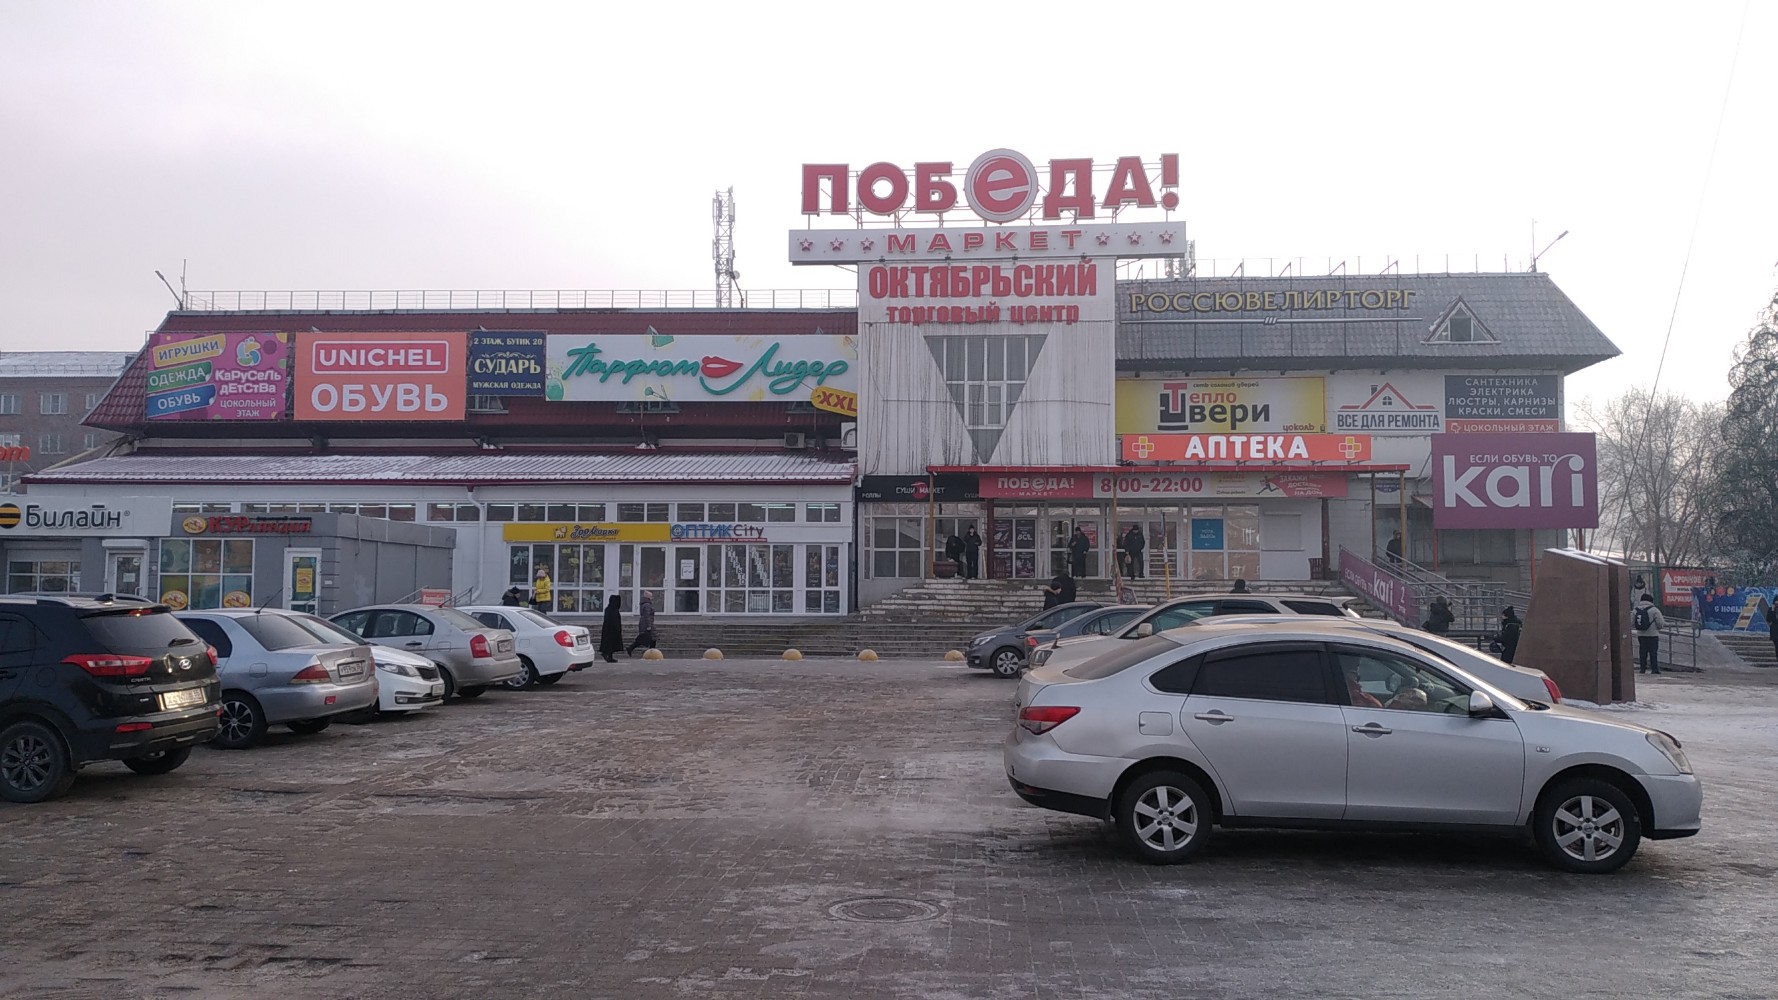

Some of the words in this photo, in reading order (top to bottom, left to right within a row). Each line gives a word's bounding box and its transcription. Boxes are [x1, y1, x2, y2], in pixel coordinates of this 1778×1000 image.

[887, 230, 1083, 252] МАРКЕТ
[869, 258, 1097, 299] ОКТЯБРЬСКИЙ
[1129, 288, 1416, 314] РОССЮВЕЛИРТОРГ
[886, 301, 1000, 326] торговый
[1010, 305, 1080, 326] центр
[159, 341, 219, 360] ИГРУШКИ
[481, 338, 504, 346] ЭТАЖ,
[319, 349, 442, 366] UNICHEL
[474, 358, 541, 376] СУДАРЬ
[149, 368, 206, 387] ОДЕЖДА
[700, 342, 849, 395] Лидер
[1465, 378, 1538, 386] САНТЕХНИКА
[157, 393, 201, 410] ОБУВЬ
[311, 384, 448, 413] ОБУВЬ
[819, 391, 857, 412] XXL
[1448, 398, 1500, 406] ЛЮСТРЫ,
[1504, 397, 1556, 405] КАРНИЗЫ
[1470, 388, 1534, 396] ЭЛЕКТРИКА
[220, 398, 276, 408] ЦОКОЛЬНЫЙ
[1458, 407, 1505, 416] КРАСКИ,
[1508, 407, 1546, 415] СМЕСИ
[1338, 414, 1359, 428] ВСЕ
[1361, 414, 1385, 429] ДЛЯ
[1387, 414, 1440, 428] РЕМОНТА
[1464, 423, 1526, 432] ЦОКОЛЬНЫЙ
[1185, 436, 1309, 459] АПТЕКА
[1470, 455, 1499, 463] ЕСЛИ
[1503, 454, 1541, 463] ОБУВЬ,
[1543, 454, 1557, 462] ТО
[1443, 454, 1585, 507] kari
[26, 505, 121, 527] Билайн
[1373, 571, 1393, 606] kari
